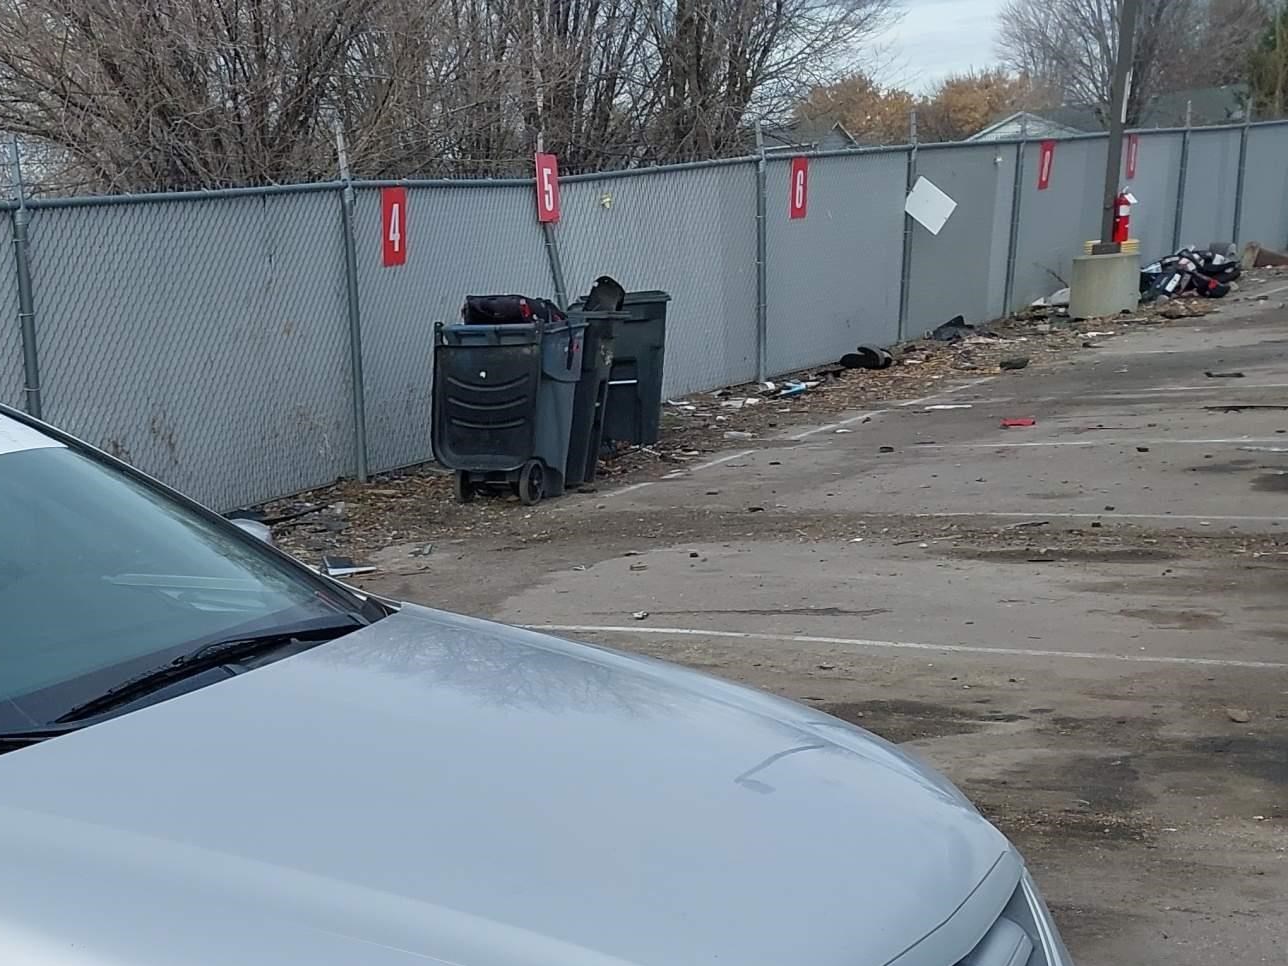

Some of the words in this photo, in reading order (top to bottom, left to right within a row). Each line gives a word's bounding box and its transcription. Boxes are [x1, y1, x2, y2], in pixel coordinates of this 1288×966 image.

[542, 168, 554, 212] 5
[795, 169, 805, 209] 6
[389, 203, 401, 252] 4
